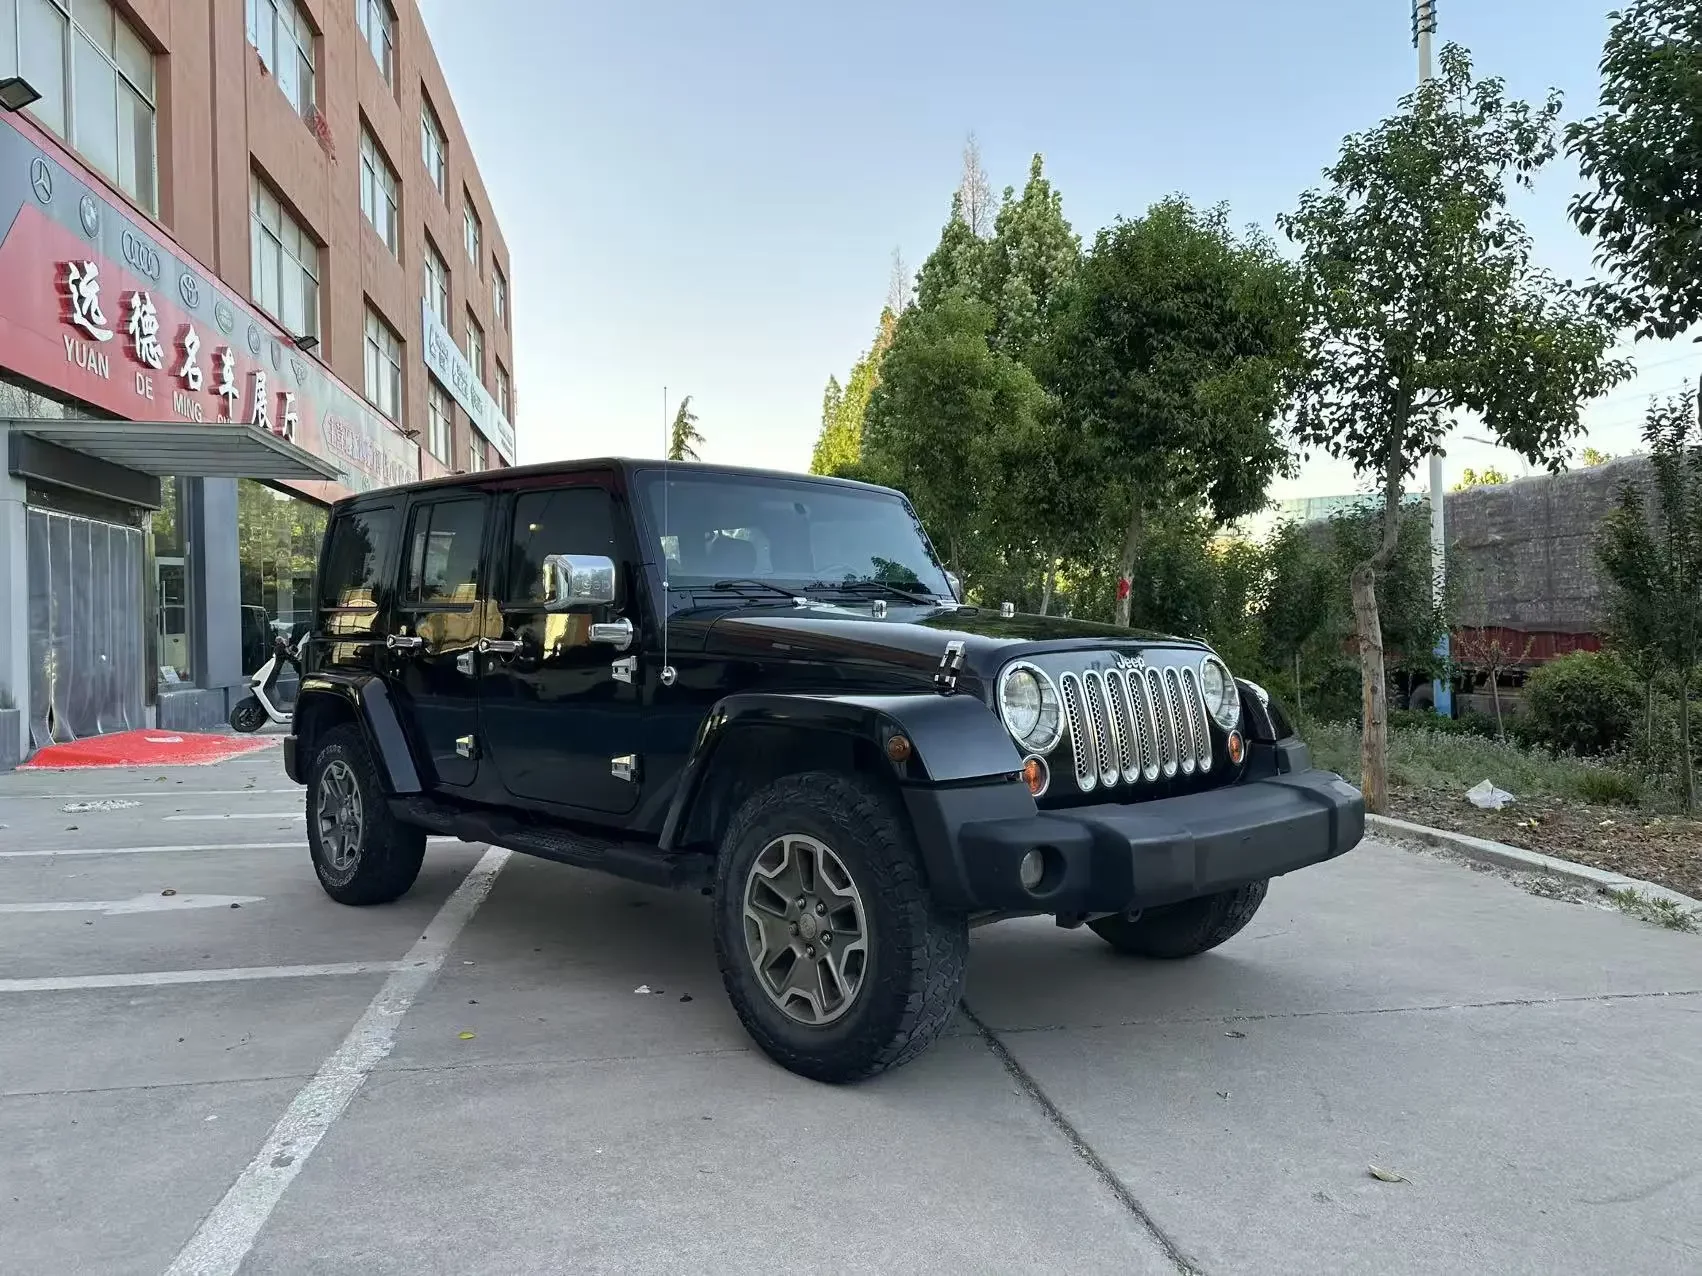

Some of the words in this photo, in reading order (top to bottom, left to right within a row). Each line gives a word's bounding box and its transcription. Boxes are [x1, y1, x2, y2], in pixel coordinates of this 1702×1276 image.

[63, 334, 109, 380] YUAN
[135, 371, 154, 400] DE
[172, 390, 203, 423] MING
[1116, 653, 1146, 671] Jeep
